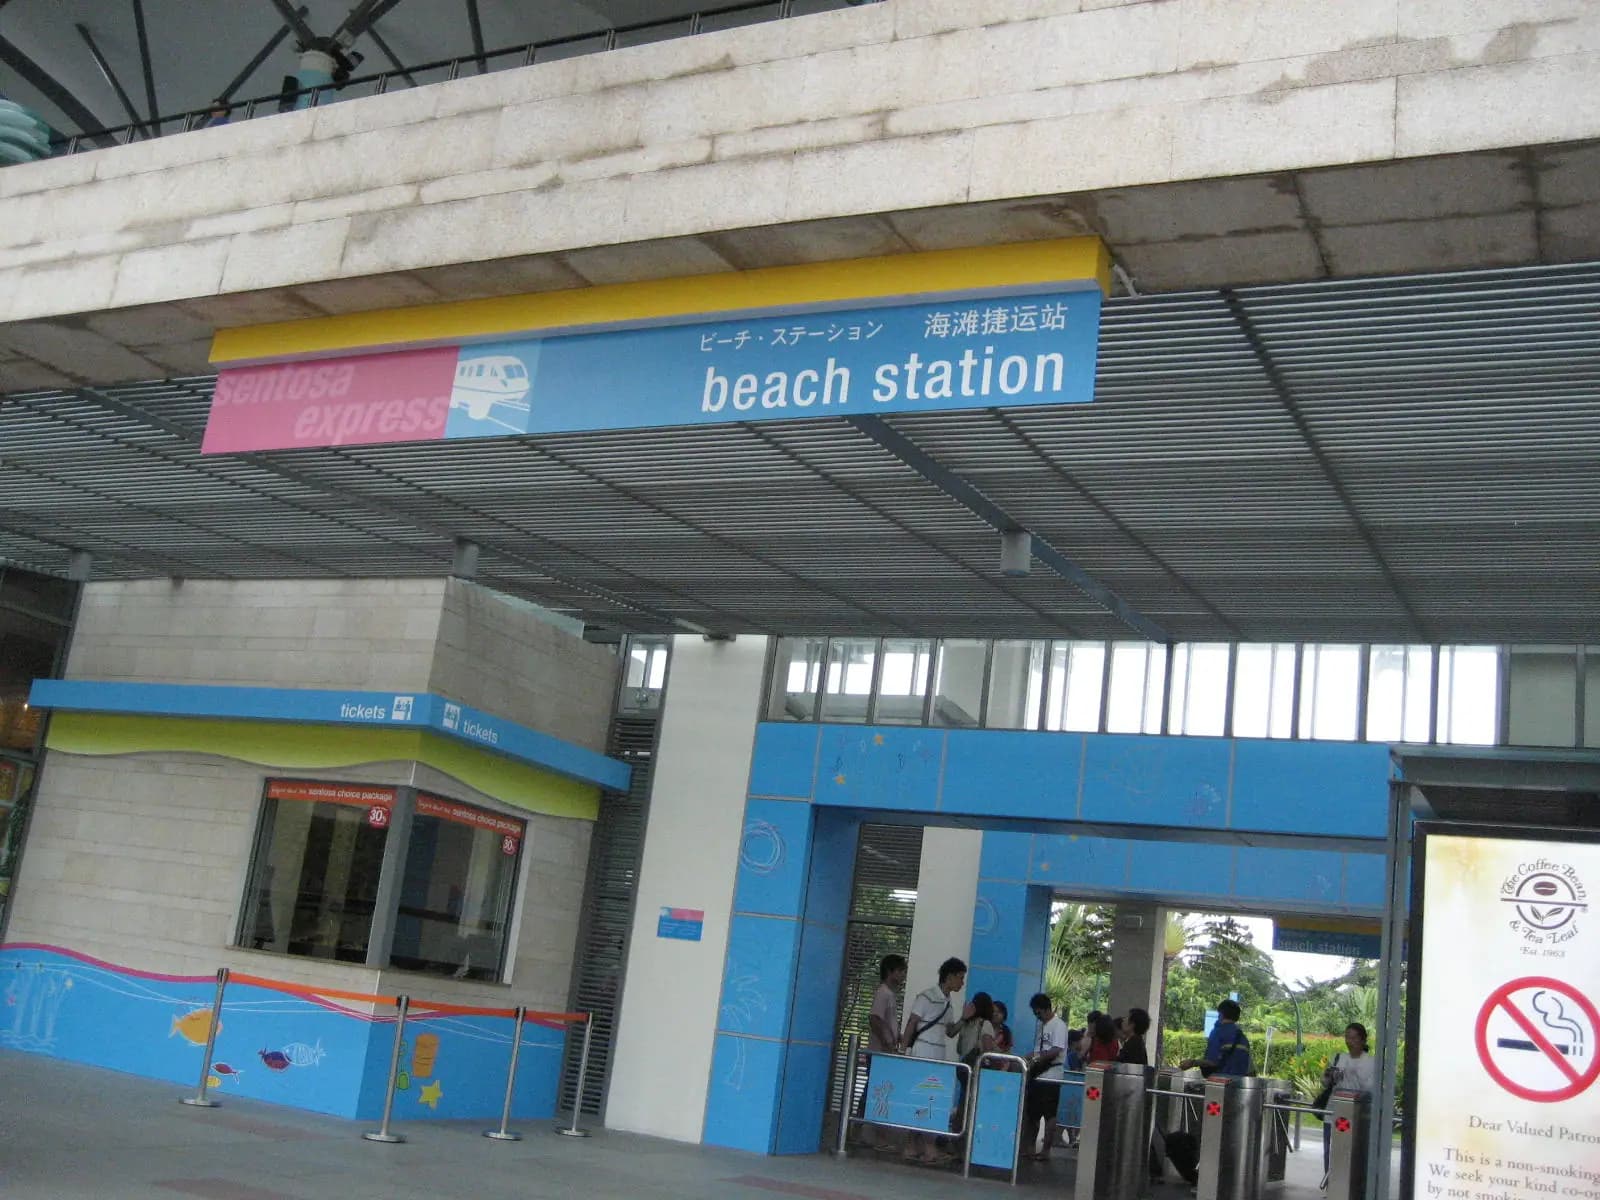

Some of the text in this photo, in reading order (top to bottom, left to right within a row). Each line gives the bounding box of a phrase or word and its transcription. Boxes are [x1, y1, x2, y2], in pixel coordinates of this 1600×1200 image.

[700, 320, 884, 352] ビーチ・ステーション
[923, 302, 1068, 339] 海滩捷运站
[212, 365, 354, 407] sentosa
[701, 346, 1065, 413] beach station
[294, 397, 447, 445] express
[340, 703, 386, 720] tickets
[463, 719, 499, 745] tickets
[1500, 857, 1587, 901] The Coffee Bean
[1521, 926, 1543, 944] Tea
[1545, 919, 1579, 944] Leaf
[1468, 1114, 1502, 1132] Dear
[1506, 1119, 1553, 1139] Valued
[1443, 1147, 1475, 1164] This
[1479, 1151, 1491, 1166] is
[1494, 1158, 1502, 1169] a
[1427, 1180, 1443, 1200] by
[1447, 1188, 1470, 1199] not
[1428, 1163, 1451, 1179] We
[1455, 1168, 1483, 1183] seek
[1488, 1176, 1520, 1189] your
[1524, 1175, 1557, 1194] kind
